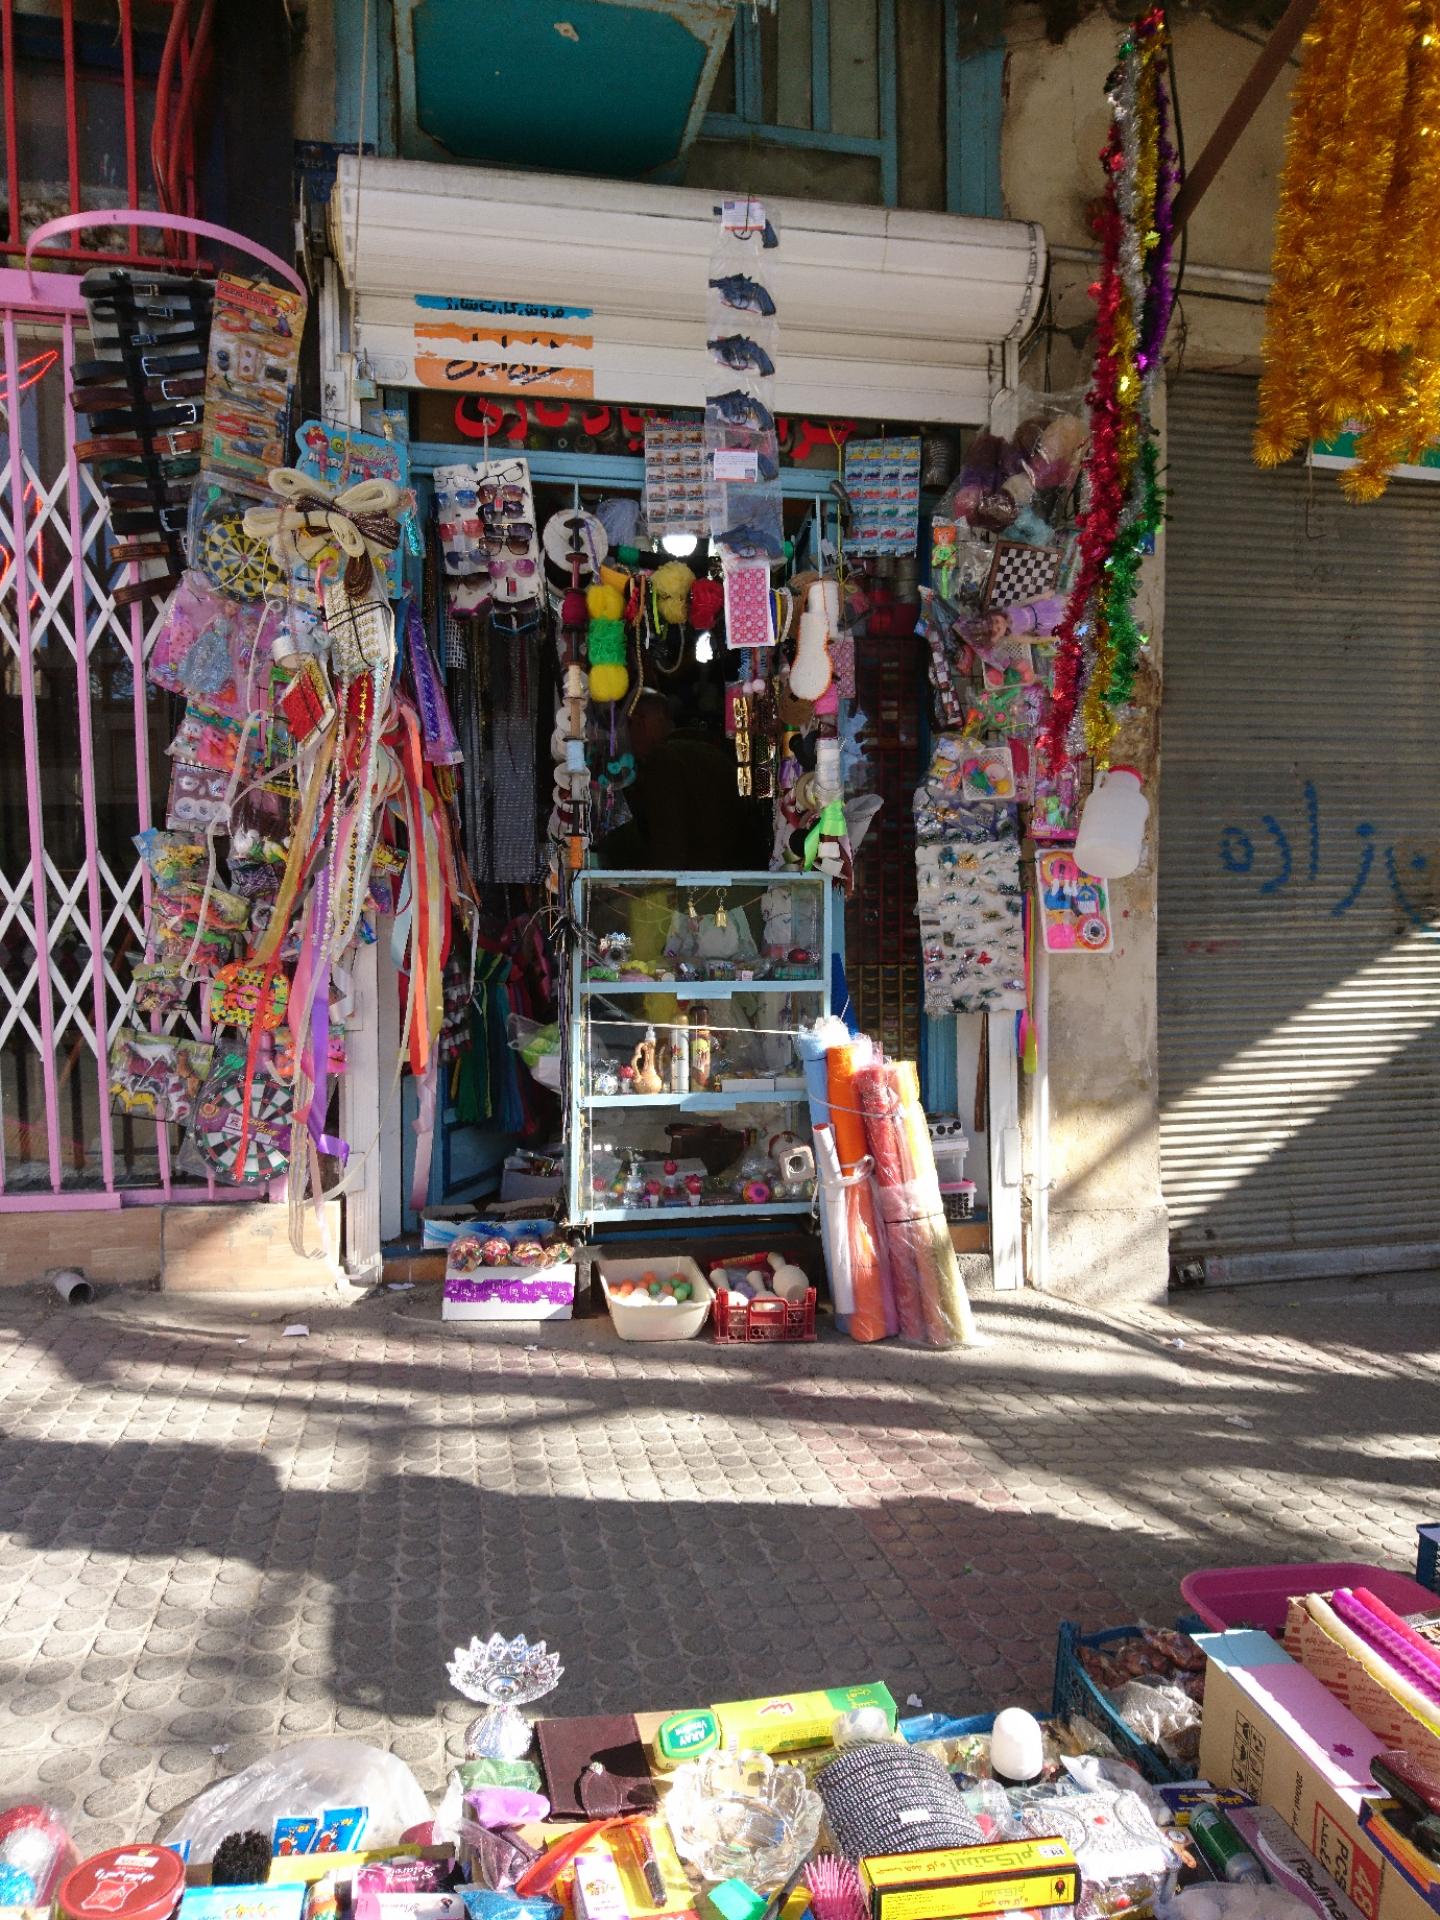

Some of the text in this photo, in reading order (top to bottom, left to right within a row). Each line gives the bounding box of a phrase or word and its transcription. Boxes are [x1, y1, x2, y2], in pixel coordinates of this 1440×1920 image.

[949, 1844, 1034, 1873] استحکام
[1336, 1838, 1349, 1891] PCS
[1289, 1856, 1348, 1920] Padina
